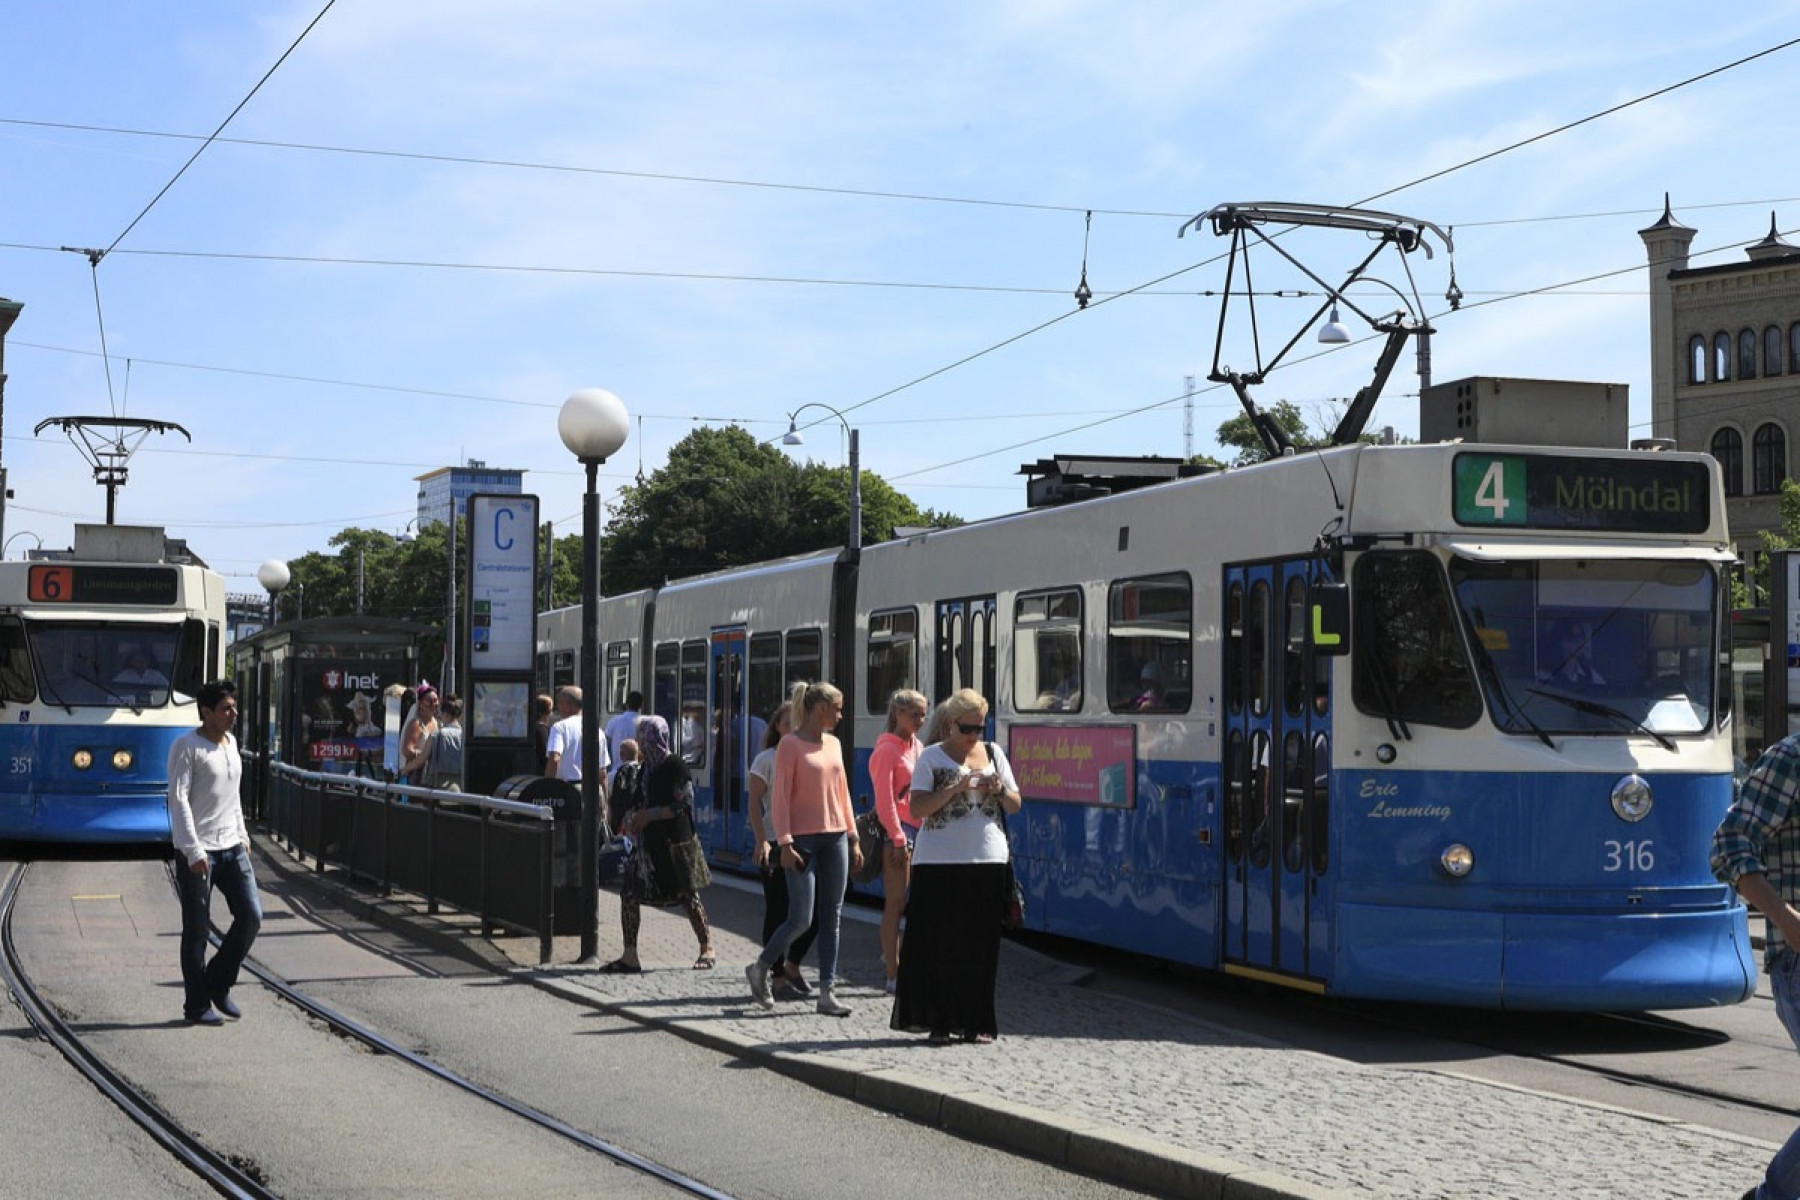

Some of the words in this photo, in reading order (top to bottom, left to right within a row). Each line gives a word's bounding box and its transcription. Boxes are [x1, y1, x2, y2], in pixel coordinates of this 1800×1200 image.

[1475, 461, 1510, 519] 4
[1554, 475, 1691, 513] Mölndal
[494, 508, 514, 550] C
[477, 562, 531, 573] Centralstationen
[43, 570, 61, 599] 6
[344, 671, 379, 689] Inet
[343, 745, 355, 756] kr
[10, 756, 32, 773] 351
[1359, 778, 1399, 797] Eric
[1367, 800, 1452, 821] Lemming
[1603, 840, 1654, 872] 316
